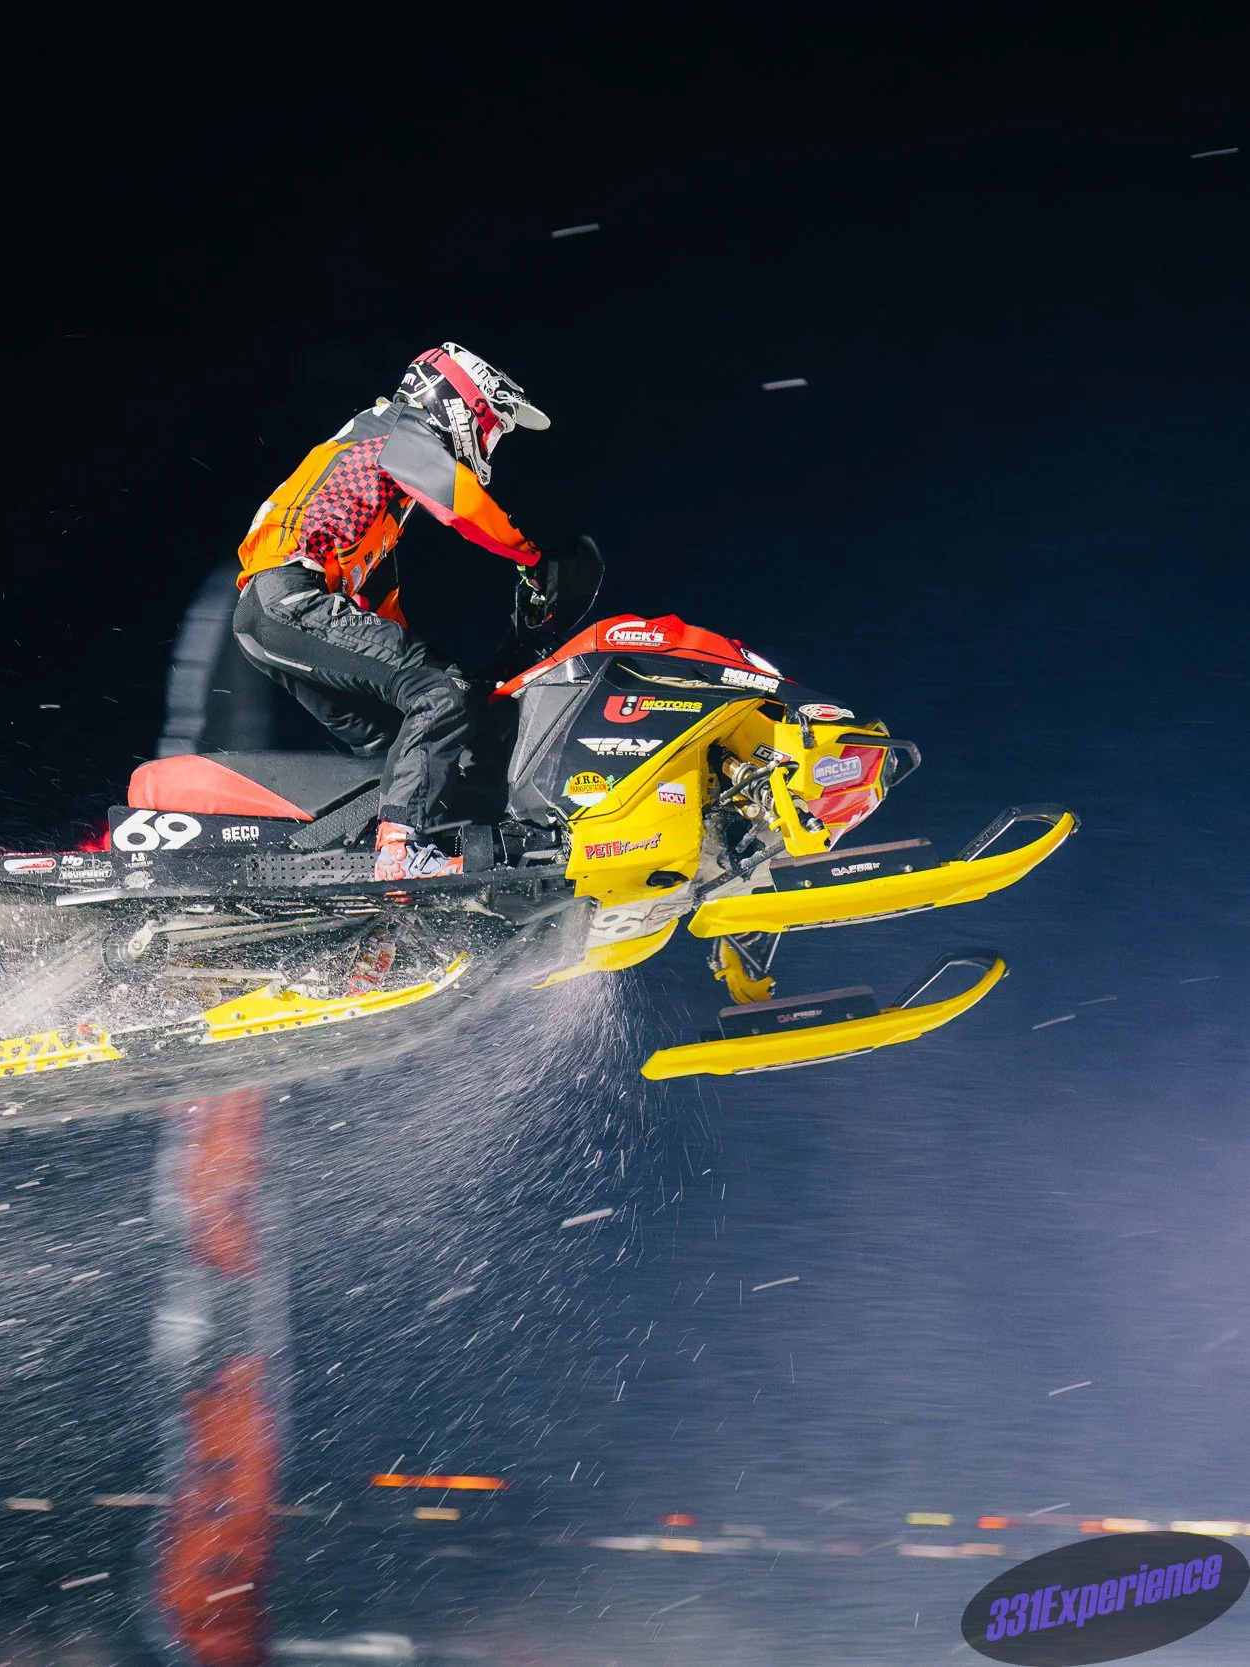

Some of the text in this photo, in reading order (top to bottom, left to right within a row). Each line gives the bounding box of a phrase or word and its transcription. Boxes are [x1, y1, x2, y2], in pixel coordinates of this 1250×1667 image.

[612, 625, 665, 643] NICK'S
[641, 700, 704, 710] MOTORS
[577, 738, 664, 752] FLY
[570, 785, 607, 794] TRANSPORTATION
[659, 791, 686, 804] MOLY
[112, 809, 203, 852] 69
[584, 841, 623, 859] PETE
[62, 855, 84, 867] HD
[62, 870, 111, 879] EQUIPMENT
